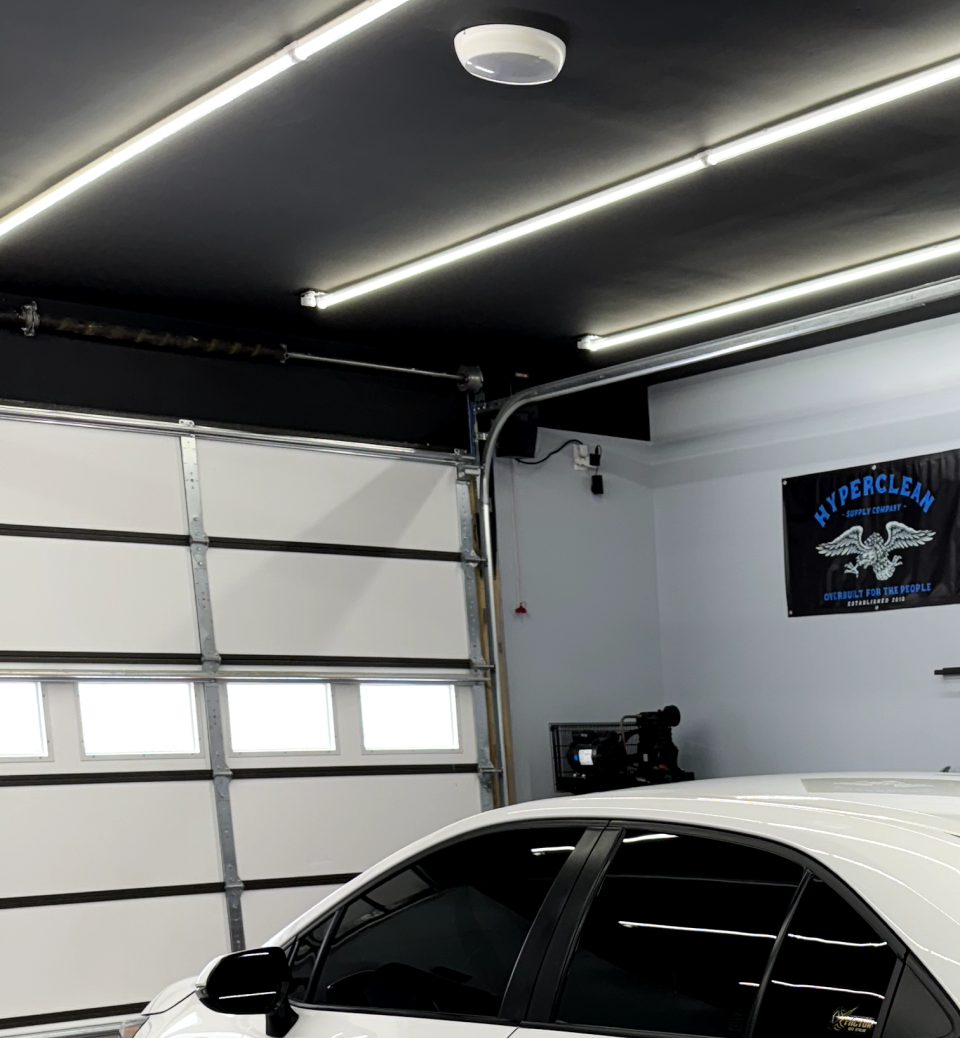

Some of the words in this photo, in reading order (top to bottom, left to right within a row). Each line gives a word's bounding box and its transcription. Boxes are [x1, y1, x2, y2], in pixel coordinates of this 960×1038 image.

[814, 474, 935, 528] HYPERCLEAN
[845, 508, 871, 518] SUPPLY
[871, 503, 902, 515] COMPANY
[823, 589, 864, 602] OVERBUILT
[865, 588, 882, 598] FOR
[882, 585, 899, 596] THE
[900, 582, 932, 594] PEOPLE
[847, 597, 889, 607] ESTABLISHED
